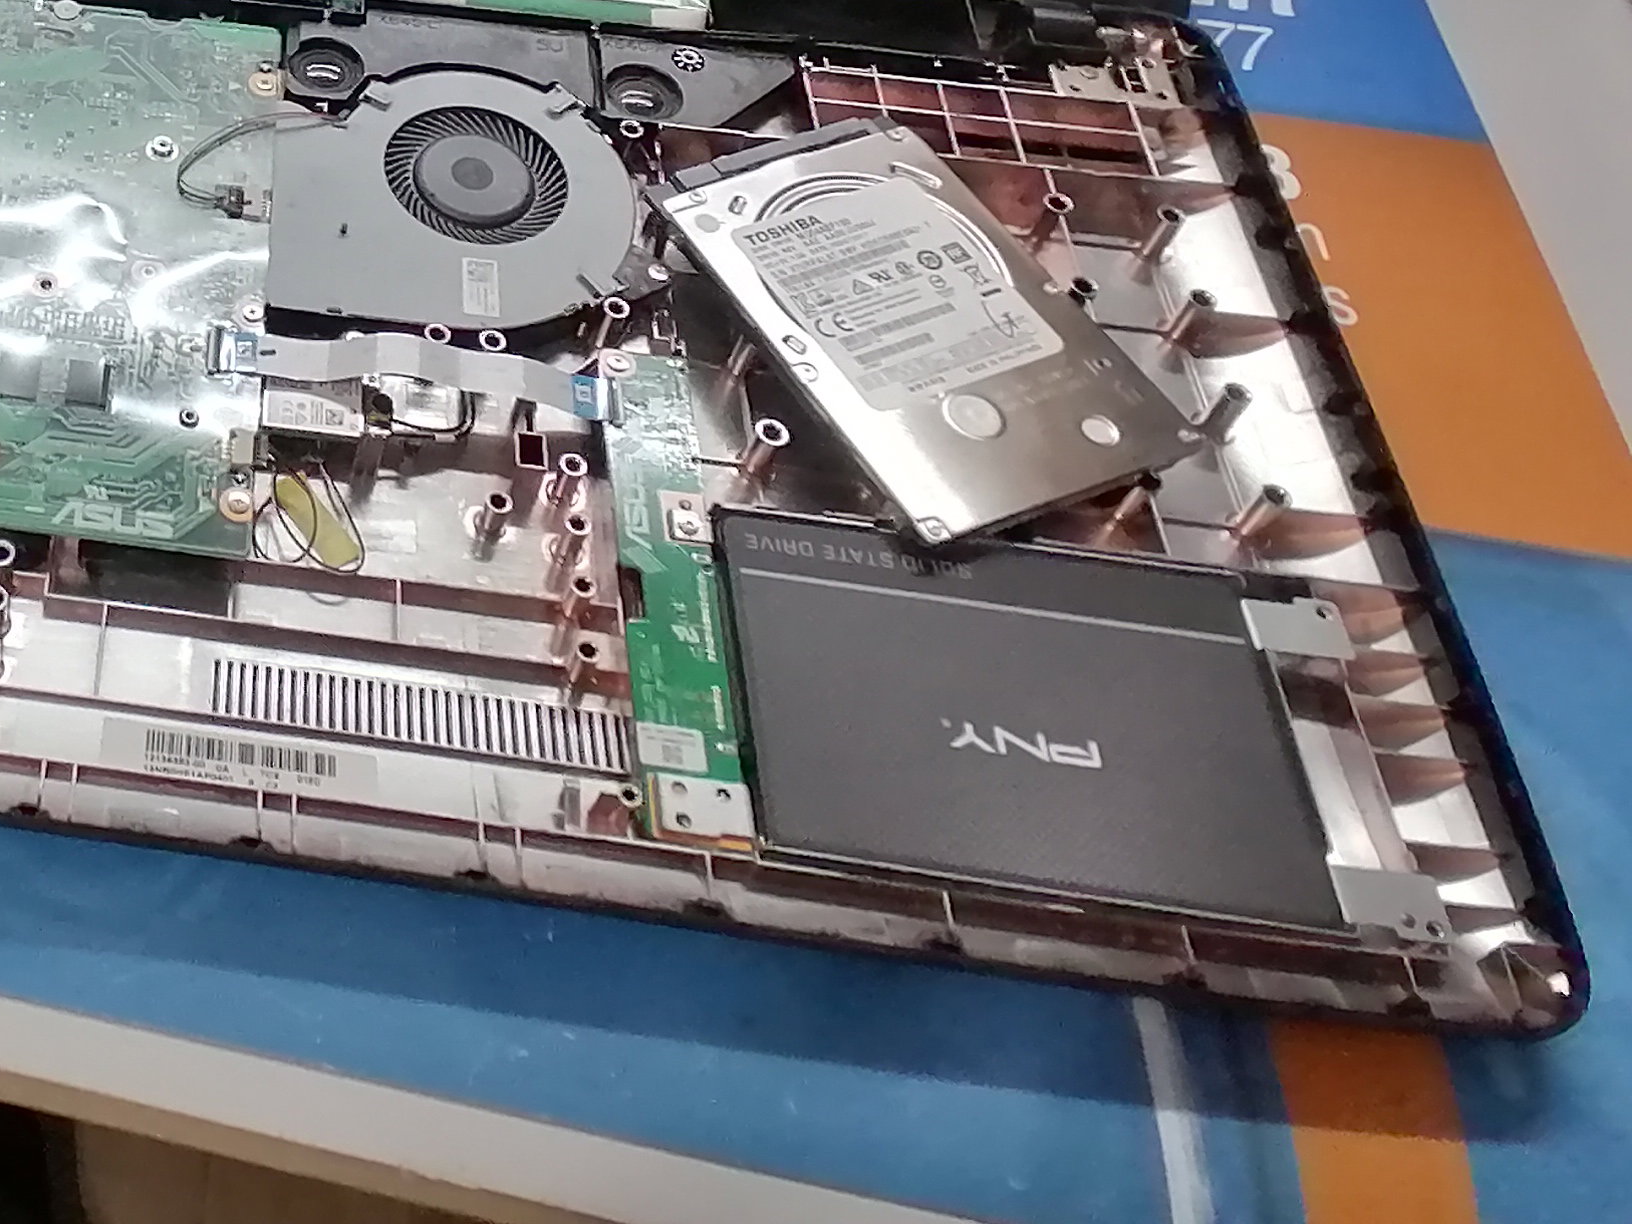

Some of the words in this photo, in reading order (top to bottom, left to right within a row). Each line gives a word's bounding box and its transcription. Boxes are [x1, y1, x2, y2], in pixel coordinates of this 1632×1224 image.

[742, 214, 823, 247] TOSHIBA
[50, 501, 175, 539] ASUS
[743, 532, 814, 558] DRIVE
[823, 544, 894, 569] STATE
